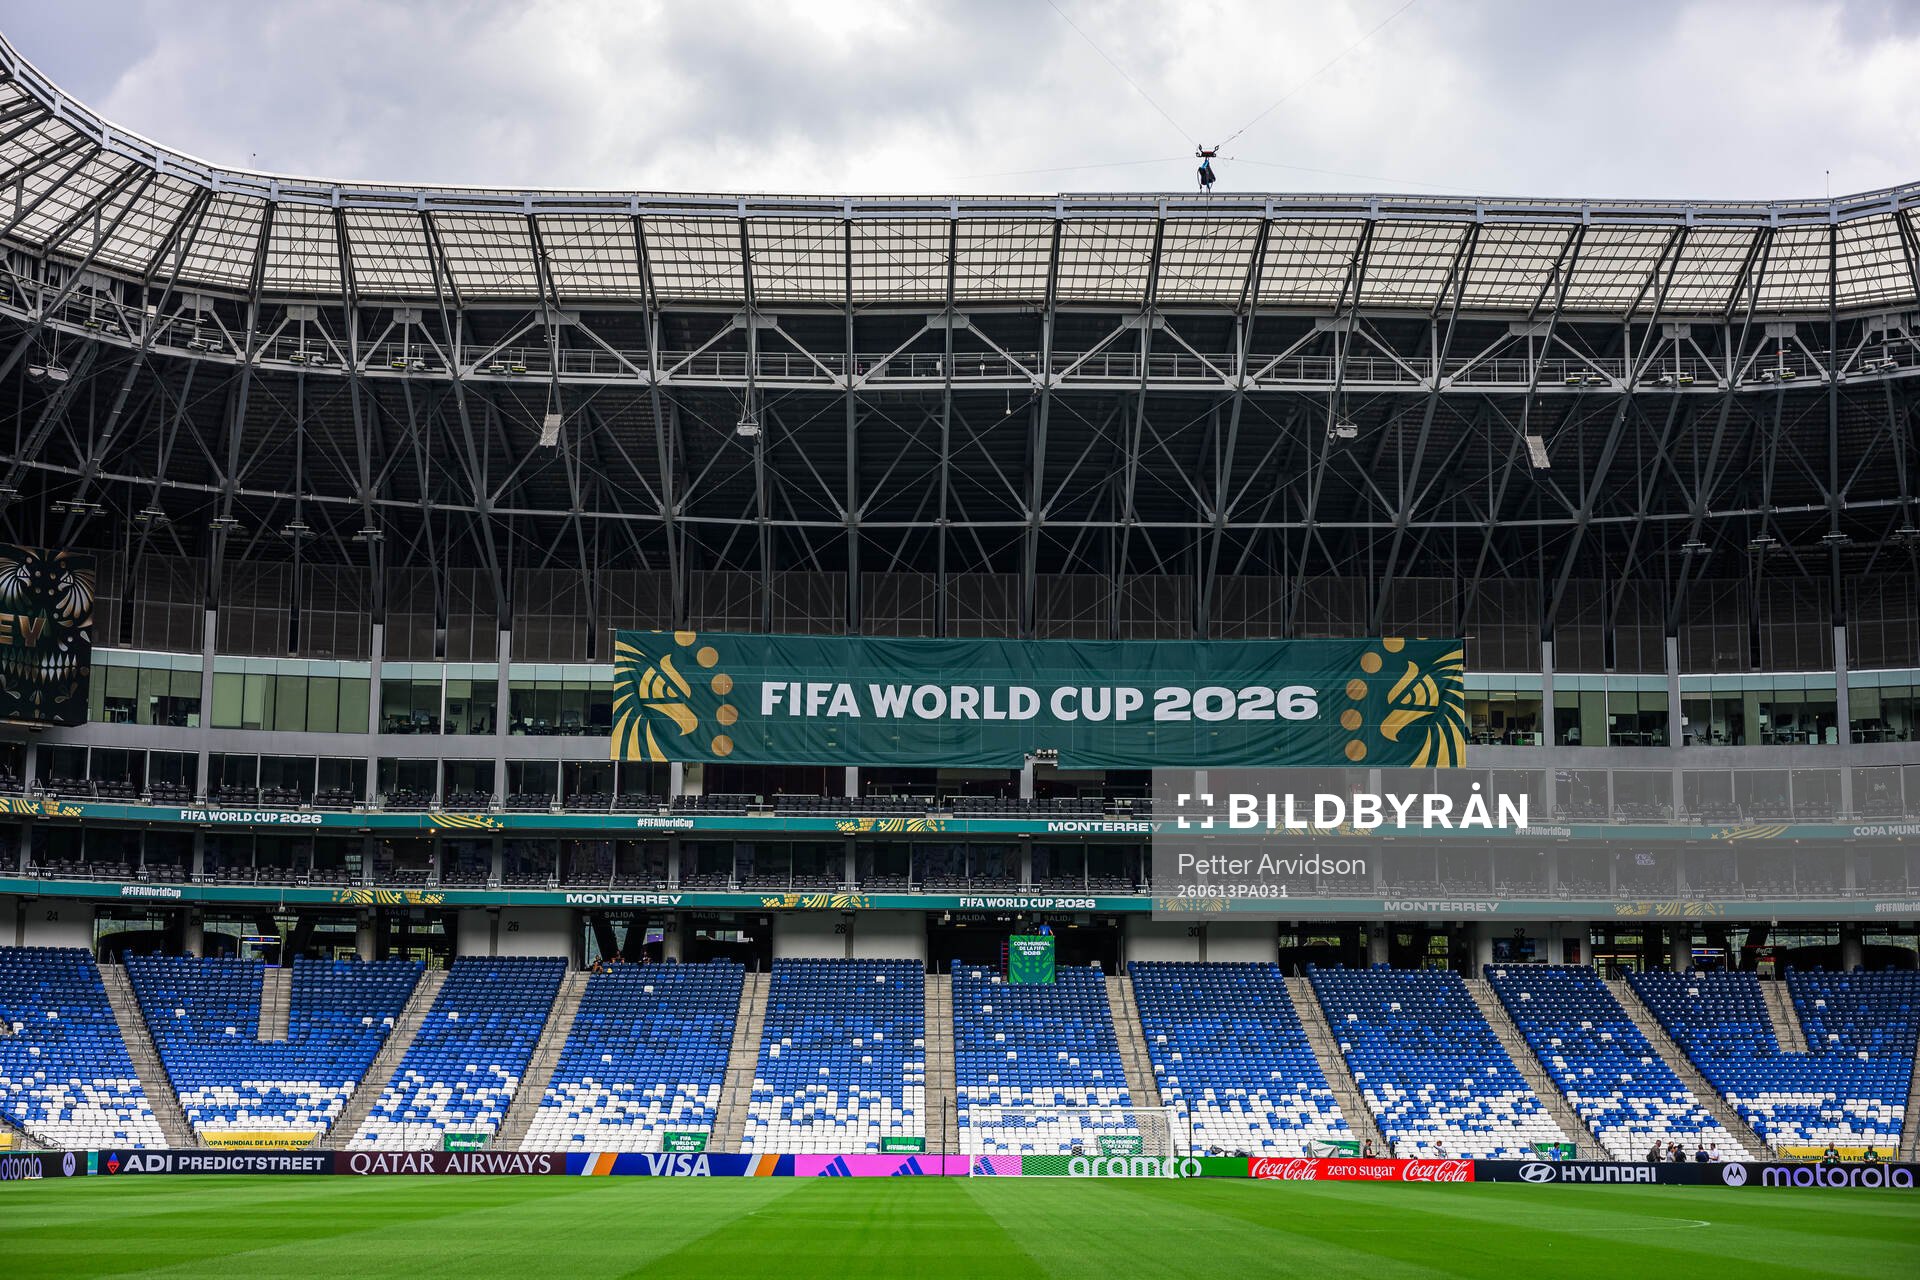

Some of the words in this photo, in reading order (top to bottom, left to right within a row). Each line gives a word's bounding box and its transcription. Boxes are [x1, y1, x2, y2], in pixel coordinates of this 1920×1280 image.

[761, 681, 861, 718] FIFA
[870, 684, 1041, 721] WORLD
[1050, 687, 1143, 722] CUP
[1153, 685, 1318, 721] 2026
[180, 811, 207, 821] FIFA
[208, 812, 251, 822] WORLD
[254, 813, 278, 823] CUP
[280, 814, 323, 824] 2026
[637, 818, 694, 829] #FIFAWorldCup
[1048, 822, 1163, 832] MONTERREY
[1515, 826, 1571, 838] #FIFAWorldCup
[1853, 826, 1887, 836] COPA
[122, 885, 182, 898] #FIFAWorldCup
[567, 894, 682, 905] MONTERREY
[960, 898, 985, 907] FIFA
[987, 898, 1028, 908] WORLD
[1030, 898, 1054, 908] CUP
[1055, 899, 1096, 909] 2026
[1384, 901, 1500, 912] MONTERREY
[1188, 927, 1199, 938] 30
[1513, 928, 1525, 938] 32
[123, 1154, 173, 1173] ADI
[179, 1156, 325, 1171] PREDICTSTREET
[350, 1153, 436, 1174] QATAR
[445, 1154, 552, 1174] AIRWAYS
[641, 1154, 712, 1177] VISA
[1068, 1157, 1203, 1179] aramco
[1251, 1158, 1319, 1181] Coca-Cola
[1327, 1165, 1357, 1177] zero
[1359, 1165, 1396, 1179] sugar
[1402, 1158, 1471, 1182] Coca-Cola
[1562, 1165, 1657, 1182] HYUNDAI
[1762, 1162, 1914, 1189] motorola
